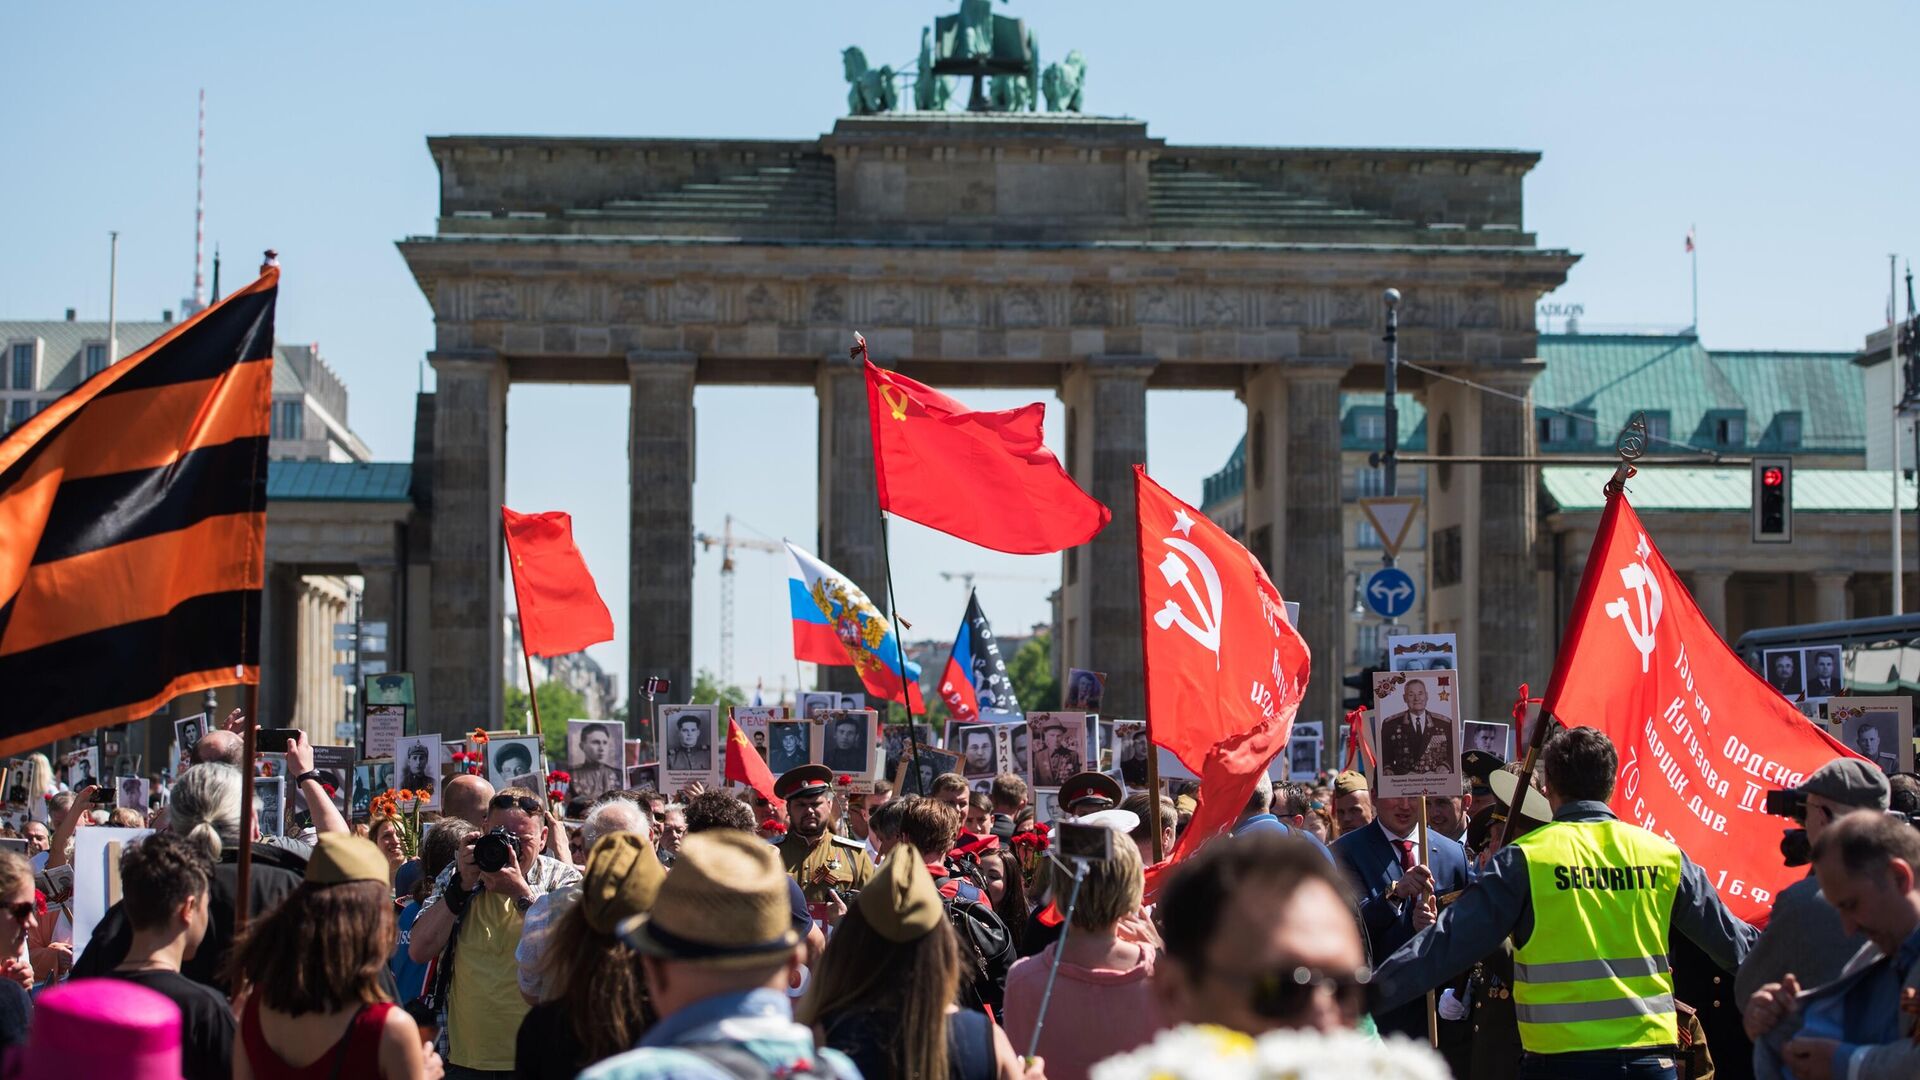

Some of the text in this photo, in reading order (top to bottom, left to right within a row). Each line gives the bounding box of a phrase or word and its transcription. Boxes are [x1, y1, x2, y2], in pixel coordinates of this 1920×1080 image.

[1540, 303, 1584, 317] ADLON
[1621, 745, 1640, 800] 79
[1554, 865, 1659, 891] SECURITY
